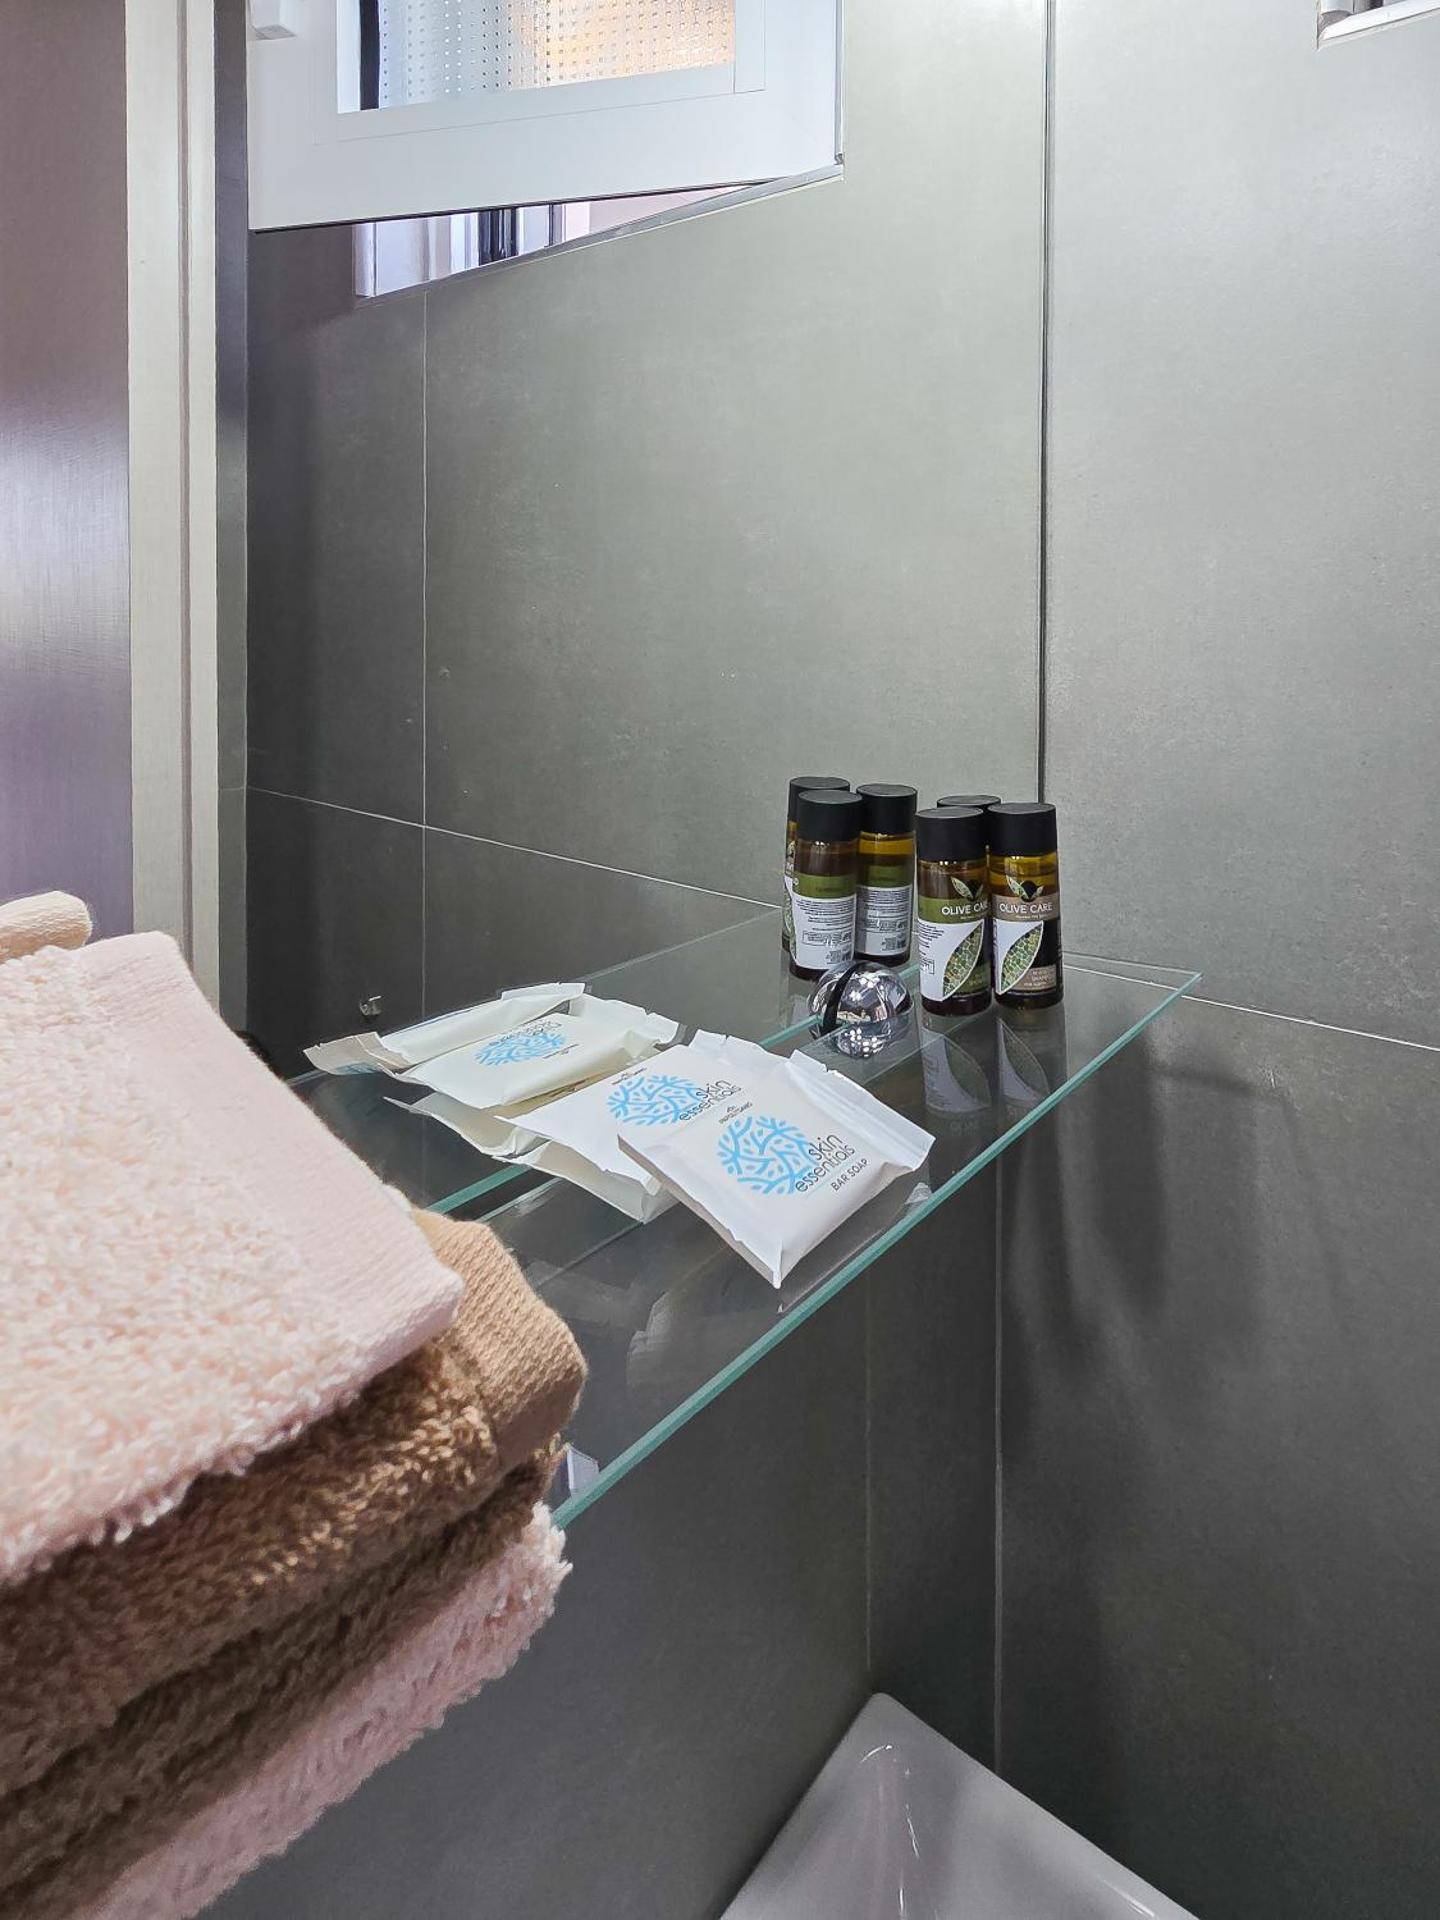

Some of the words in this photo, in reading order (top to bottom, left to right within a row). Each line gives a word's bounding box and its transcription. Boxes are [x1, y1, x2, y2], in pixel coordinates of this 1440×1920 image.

[941, 904, 971, 915] OLIVE
[999, 903, 1027, 914] OLIVE
[1029, 902, 1053, 914] CARE
[695, 1079, 734, 1100] skin
[808, 1133, 844, 1161] skin
[795, 1144, 856, 1193] essentials
[830, 1173, 849, 1191] BAR
[848, 1158, 869, 1179] SOAP
